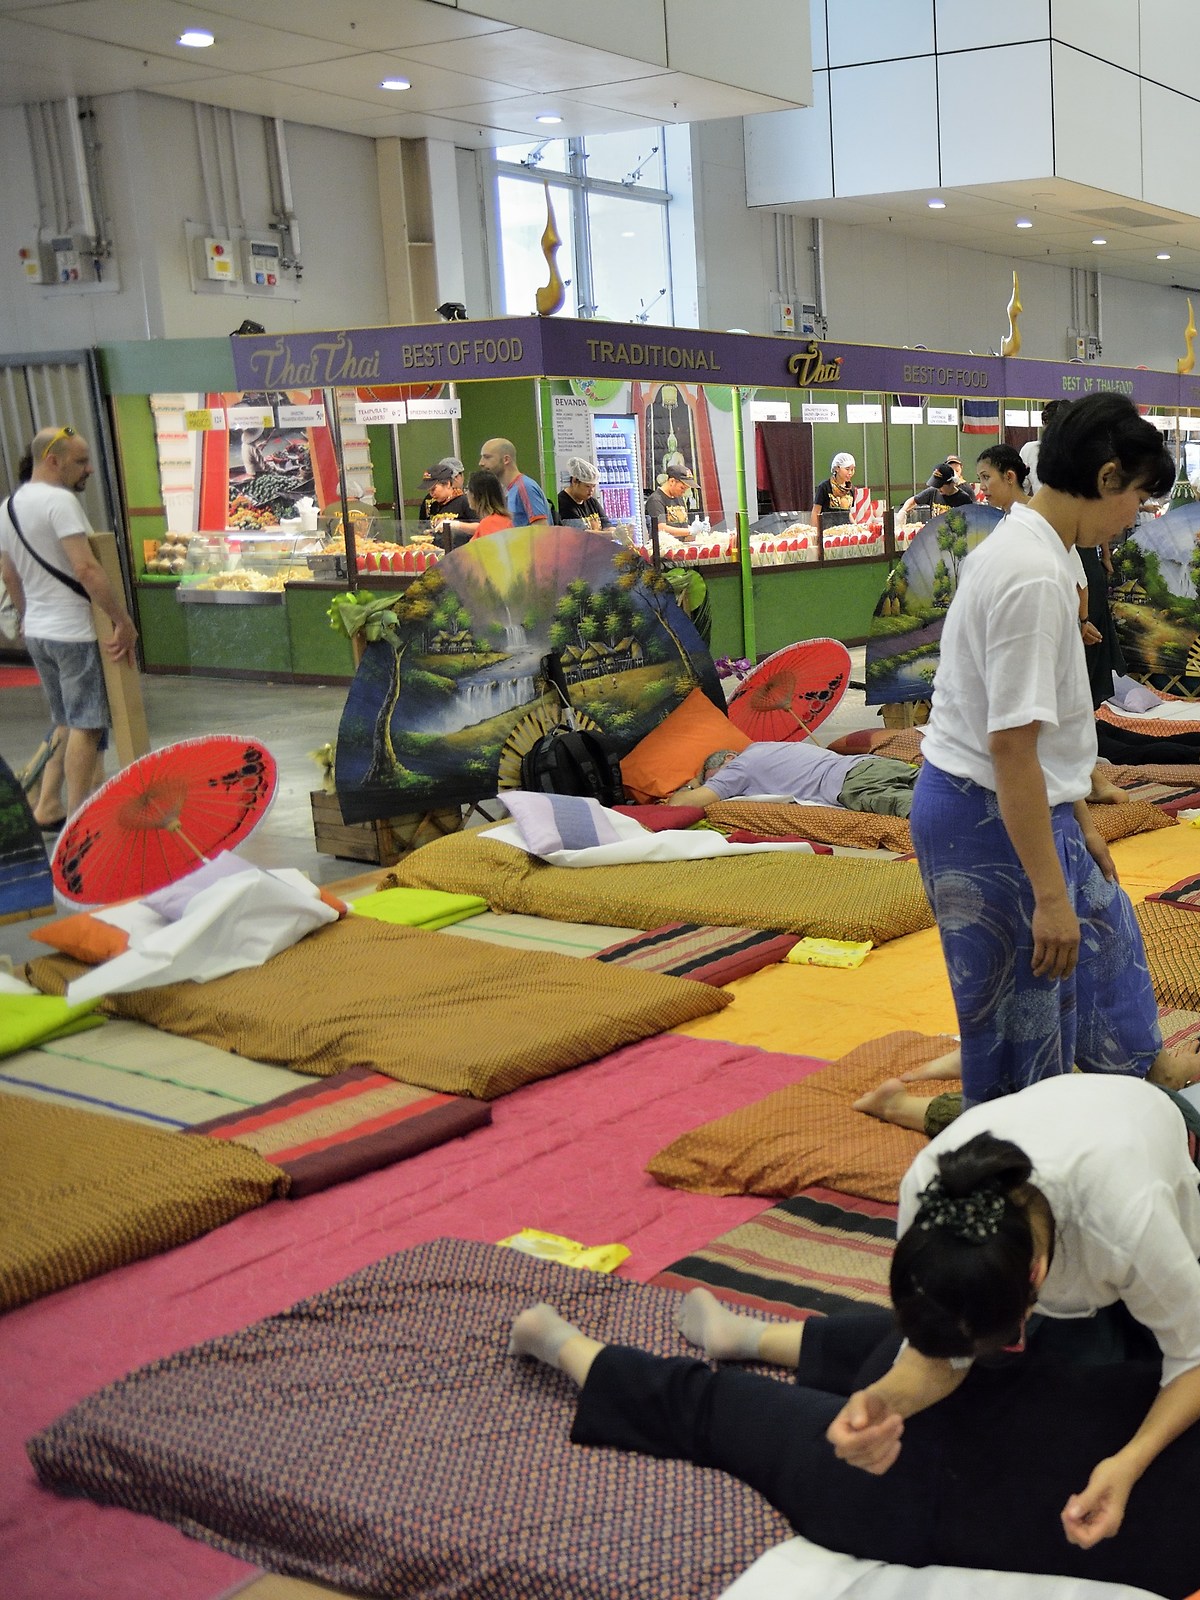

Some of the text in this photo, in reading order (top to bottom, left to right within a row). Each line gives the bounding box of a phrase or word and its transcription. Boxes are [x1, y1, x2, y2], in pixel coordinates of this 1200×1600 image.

[251, 331, 524, 389] Thai Thai BEST OF FOOD
[586, 339, 721, 371] TRADITIONAL
[788, 340, 842, 387] Thai
[904, 365, 989, 389] BEST OF FOOD
[1062, 375, 1080, 391] BEST
[1084, 377, 1094, 392] OF
[555, 398, 588, 407] BEVANDA
